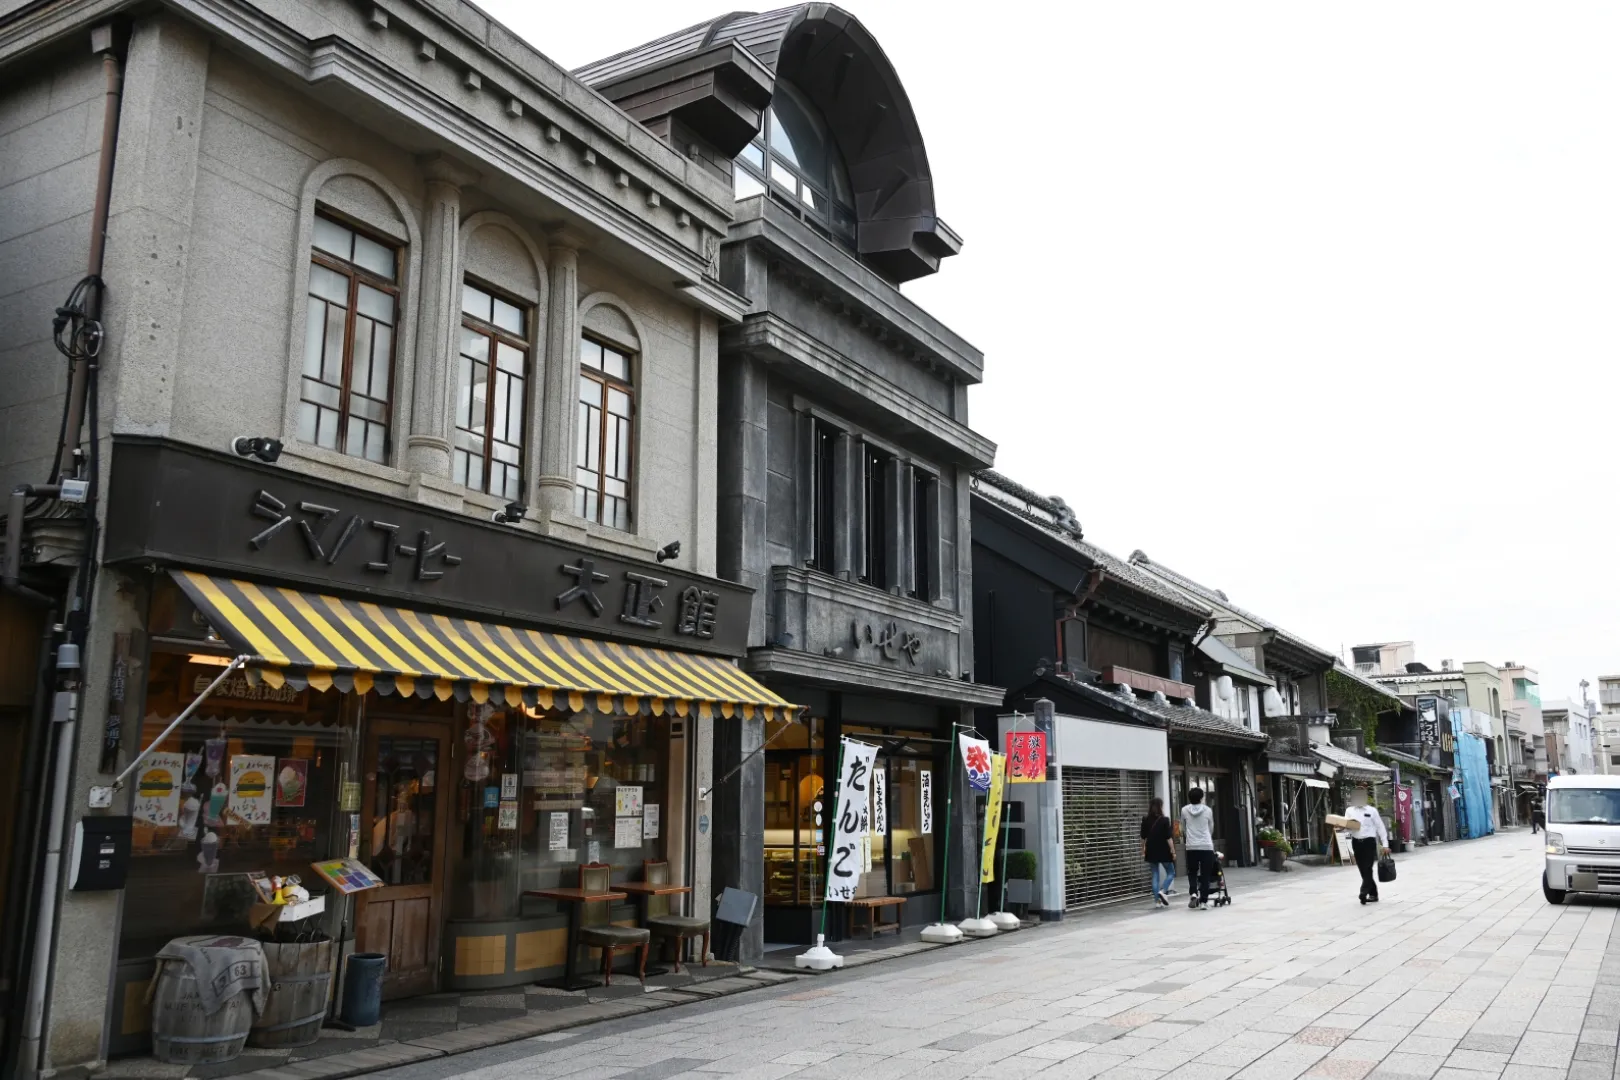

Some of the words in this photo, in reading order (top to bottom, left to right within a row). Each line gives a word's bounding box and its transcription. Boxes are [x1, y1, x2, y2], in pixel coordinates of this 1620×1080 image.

[556, 557, 719, 641] 大正館
[851, 618, 922, 667] いせや
[966, 745, 990, 774] 氷
[1012, 735, 1025, 777] だんご
[1028, 735, 1042, 762] 激辛
[832, 755, 870, 878] だんご
[874, 773, 885, 833] いもようかん
[921, 773, 932, 831] 酒まんじゅう
